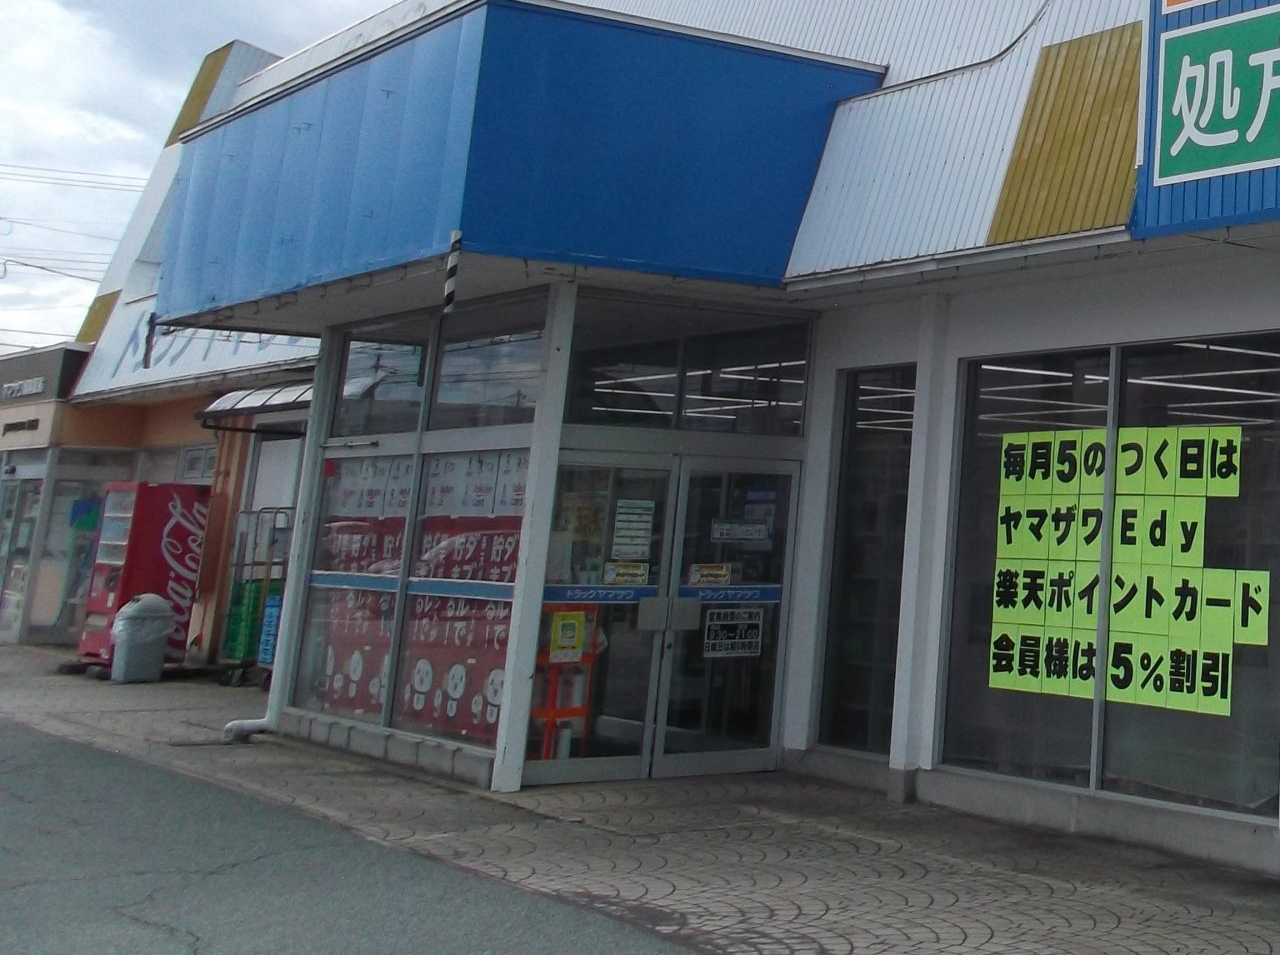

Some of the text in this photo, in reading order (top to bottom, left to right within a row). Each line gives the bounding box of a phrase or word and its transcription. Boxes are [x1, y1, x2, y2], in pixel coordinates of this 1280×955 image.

[160, 492, 209, 661] oca-Cola
[995, 569, 1263, 628] 楽天ポイントカード
